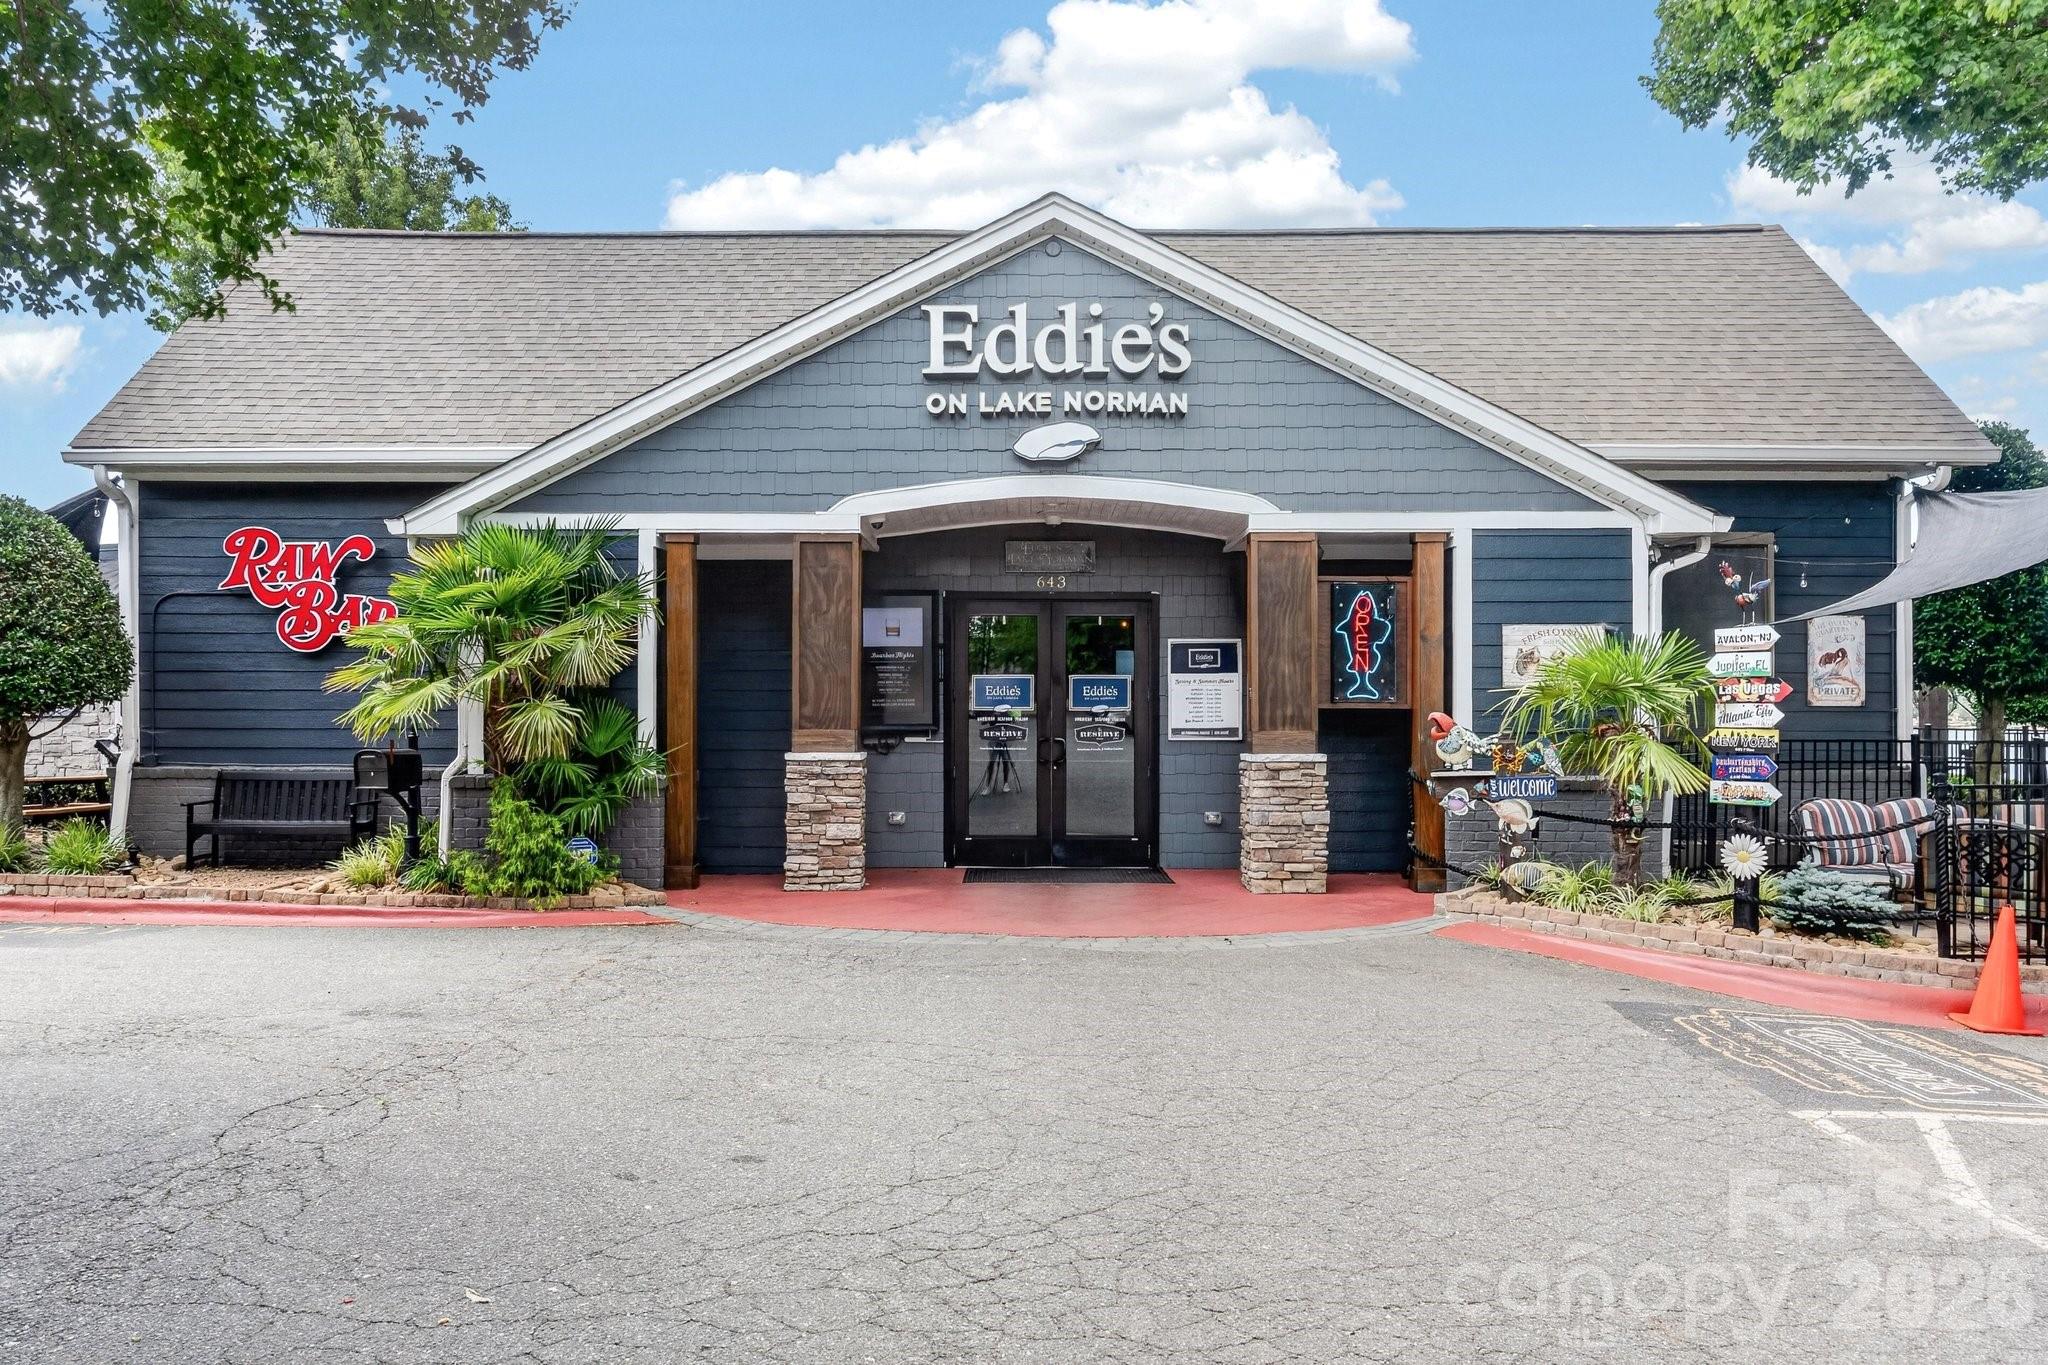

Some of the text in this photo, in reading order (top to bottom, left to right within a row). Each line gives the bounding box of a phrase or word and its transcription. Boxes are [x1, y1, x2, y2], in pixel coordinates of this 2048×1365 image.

[921, 302, 1192, 379] Eddie's
[926, 391, 1188, 417] ON LAKE NORMAN
[218, 526, 376, 609] RAW
[1037, 576, 1066, 589] 643
[1356, 596, 1371, 672] OPEN
[1522, 629, 1550, 645] FRESH
[1717, 633, 1772, 644] AVALON, NJ
[1755, 660, 1768, 670] FL
[985, 685, 1021, 696] Eddie's
[1083, 685, 1118, 696] Eddie's
[1719, 683, 1781, 695] Las Vegas
[1818, 687, 1856, 695] PRIVATE
[1717, 705, 1774, 725] Atlantic City
[1711, 736, 1777, 748] NEW YORK
